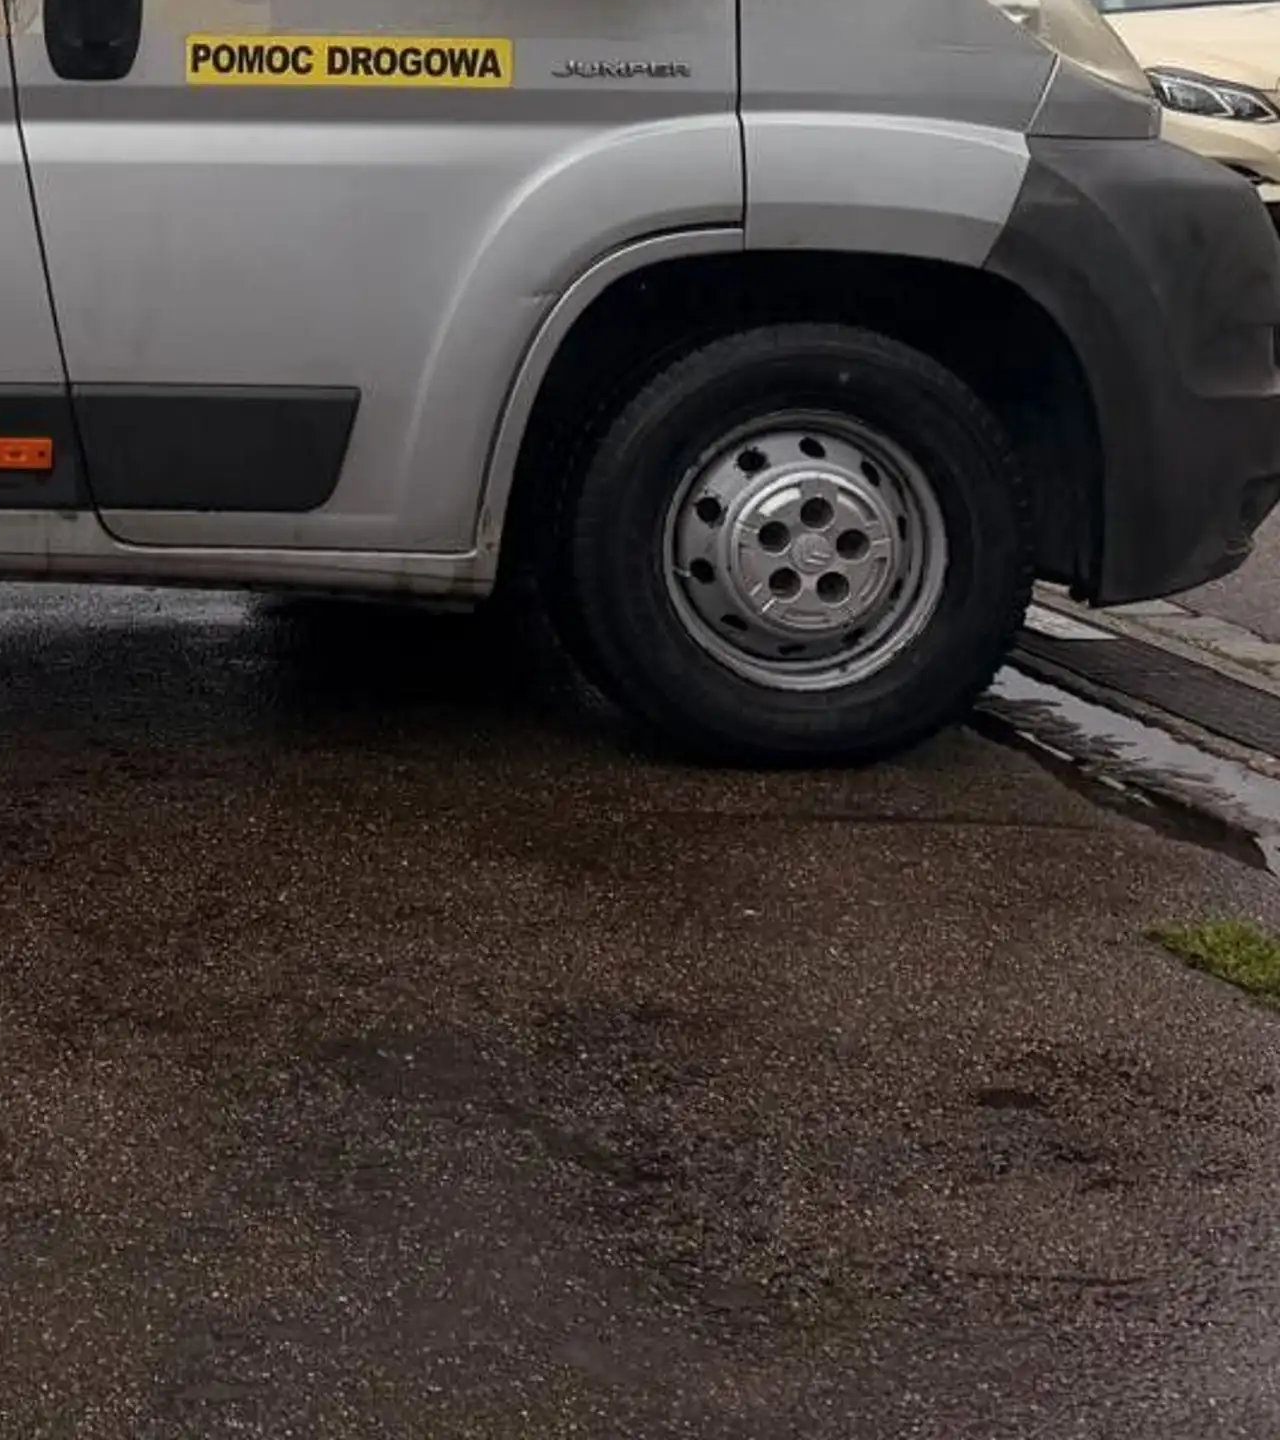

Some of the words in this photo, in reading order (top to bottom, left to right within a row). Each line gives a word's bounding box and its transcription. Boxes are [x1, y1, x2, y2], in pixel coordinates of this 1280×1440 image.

[190, 43, 316, 77] POMOC
[326, 45, 504, 80] DROGOWA
[550, 59, 693, 79] JUMPER
